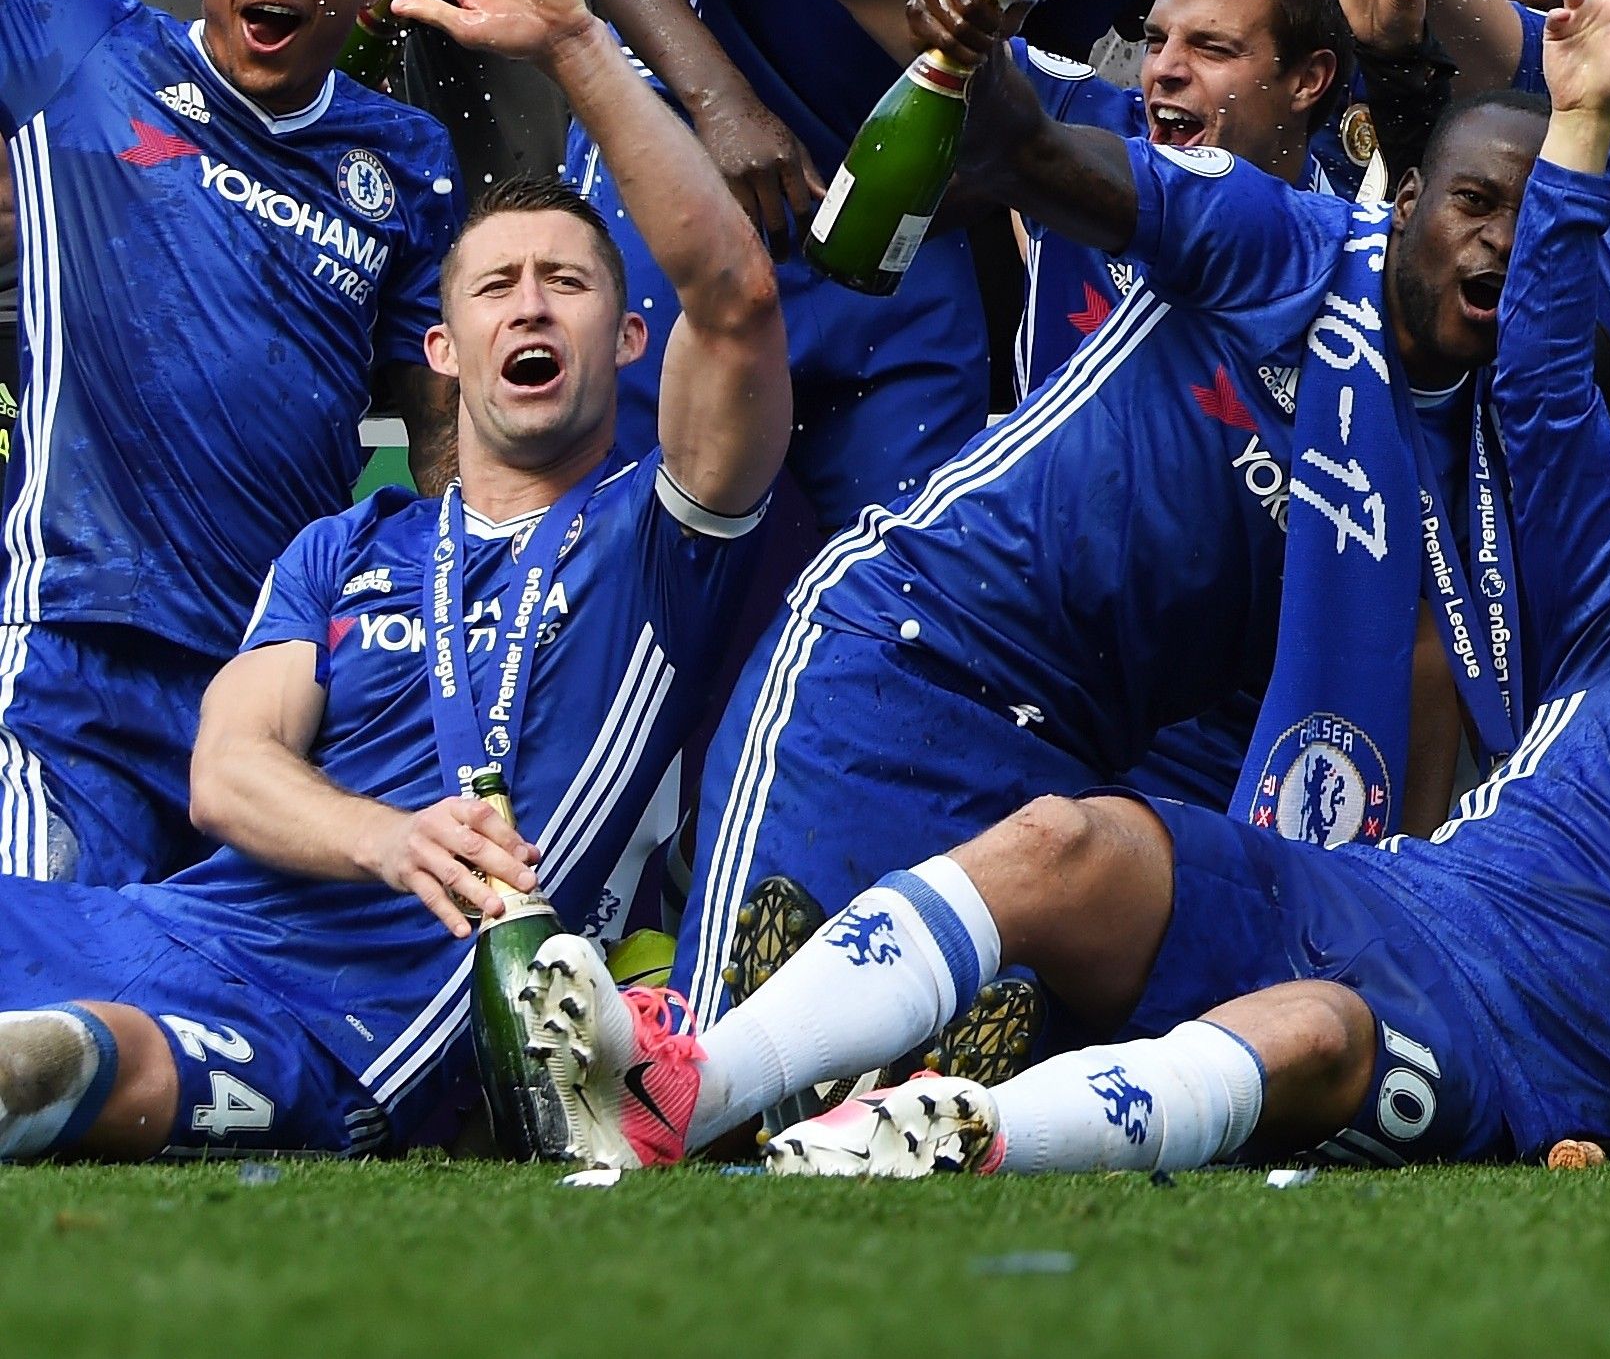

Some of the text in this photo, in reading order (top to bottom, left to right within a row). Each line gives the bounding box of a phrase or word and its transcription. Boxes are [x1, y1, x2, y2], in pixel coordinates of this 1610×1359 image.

[155, 90, 211, 125] adidas
[347, 149, 384, 175] CHELSEA
[199, 154, 390, 279] YOKOHAMA
[312, 252, 376, 306] TYRES
[1256, 363, 1297, 416] adidas
[1420, 516, 1481, 680] Premier League
[1473, 403, 1514, 682] League Premier League
[432, 558, 457, 699] Premier League
[488, 567, 543, 722] Premier League
[158, 1012, 276, 1140] 24
[1375, 1019, 1443, 1142] 10
